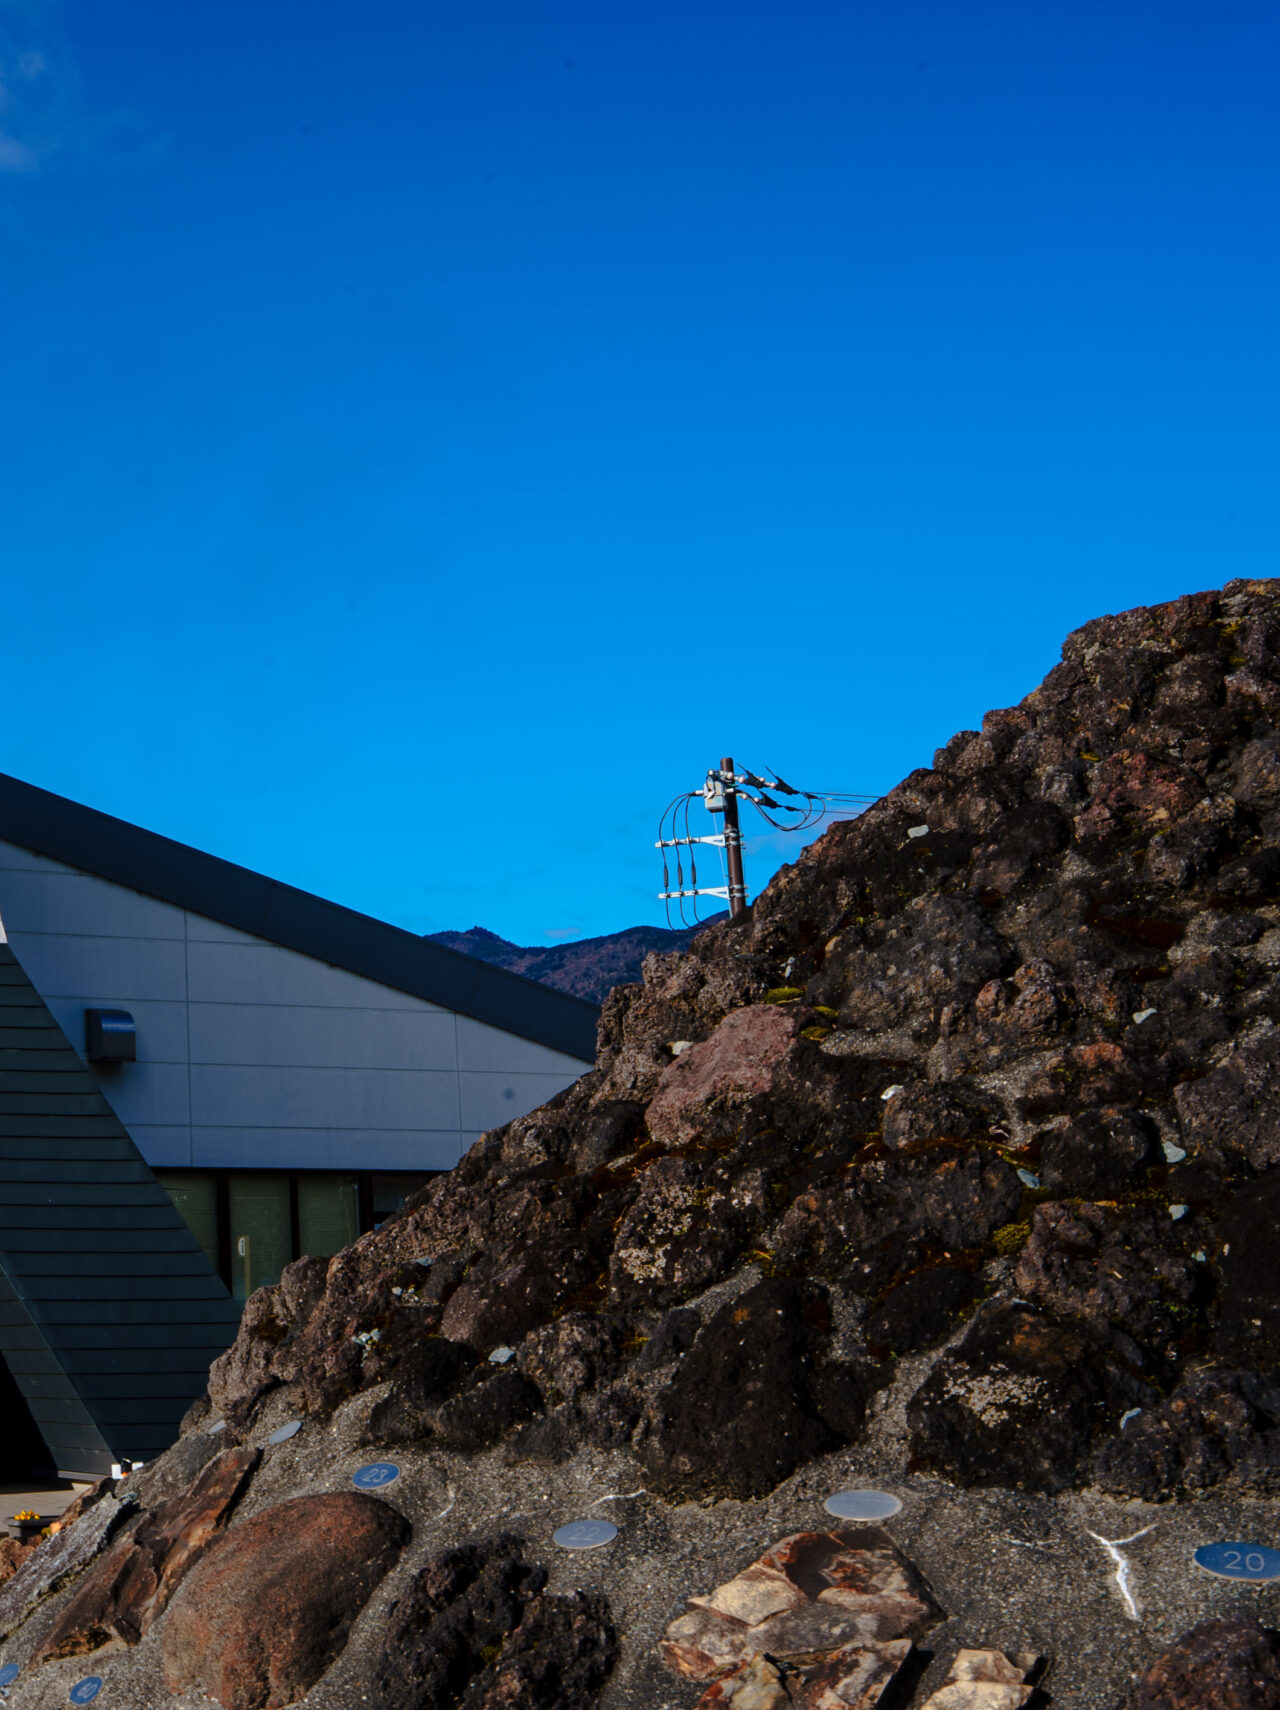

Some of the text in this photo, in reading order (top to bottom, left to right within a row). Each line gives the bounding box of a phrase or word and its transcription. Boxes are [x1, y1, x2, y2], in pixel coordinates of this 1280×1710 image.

[361, 1468, 388, 1483] 23
[568, 1526, 600, 1541] 22
[1223, 1551, 1265, 1572] 20
